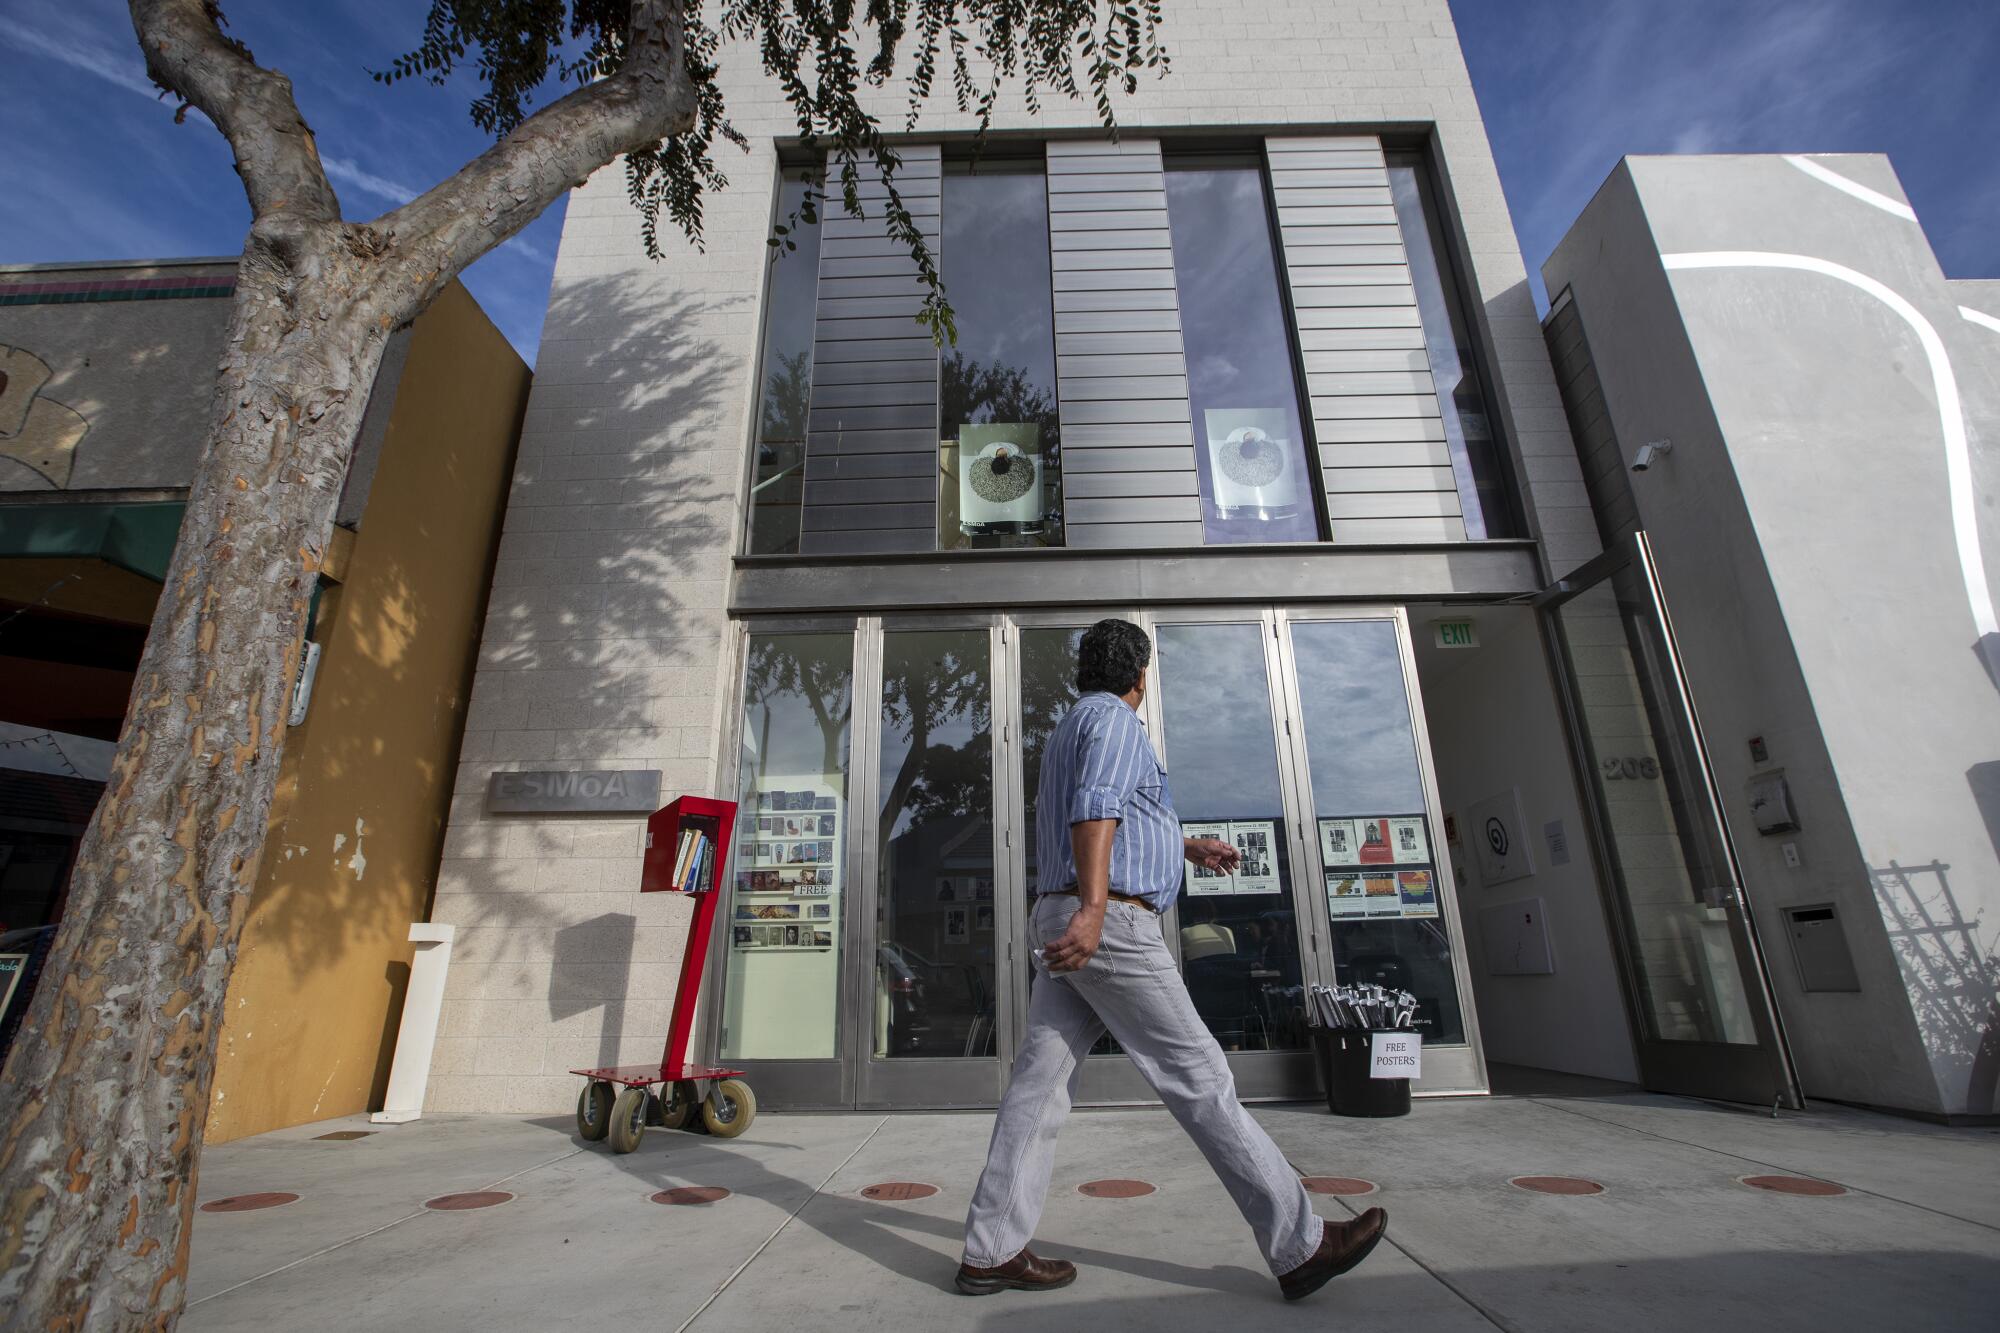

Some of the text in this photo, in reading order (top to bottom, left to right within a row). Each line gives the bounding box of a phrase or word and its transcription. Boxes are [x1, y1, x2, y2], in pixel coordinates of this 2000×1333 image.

[1440, 623, 1472, 644] EXIT
[1603, 757, 1660, 780] 208
[800, 885, 828, 895] FREE
[1386, 1043, 1407, 1052] FREE
[1376, 1056, 1416, 1066] POSTERS
